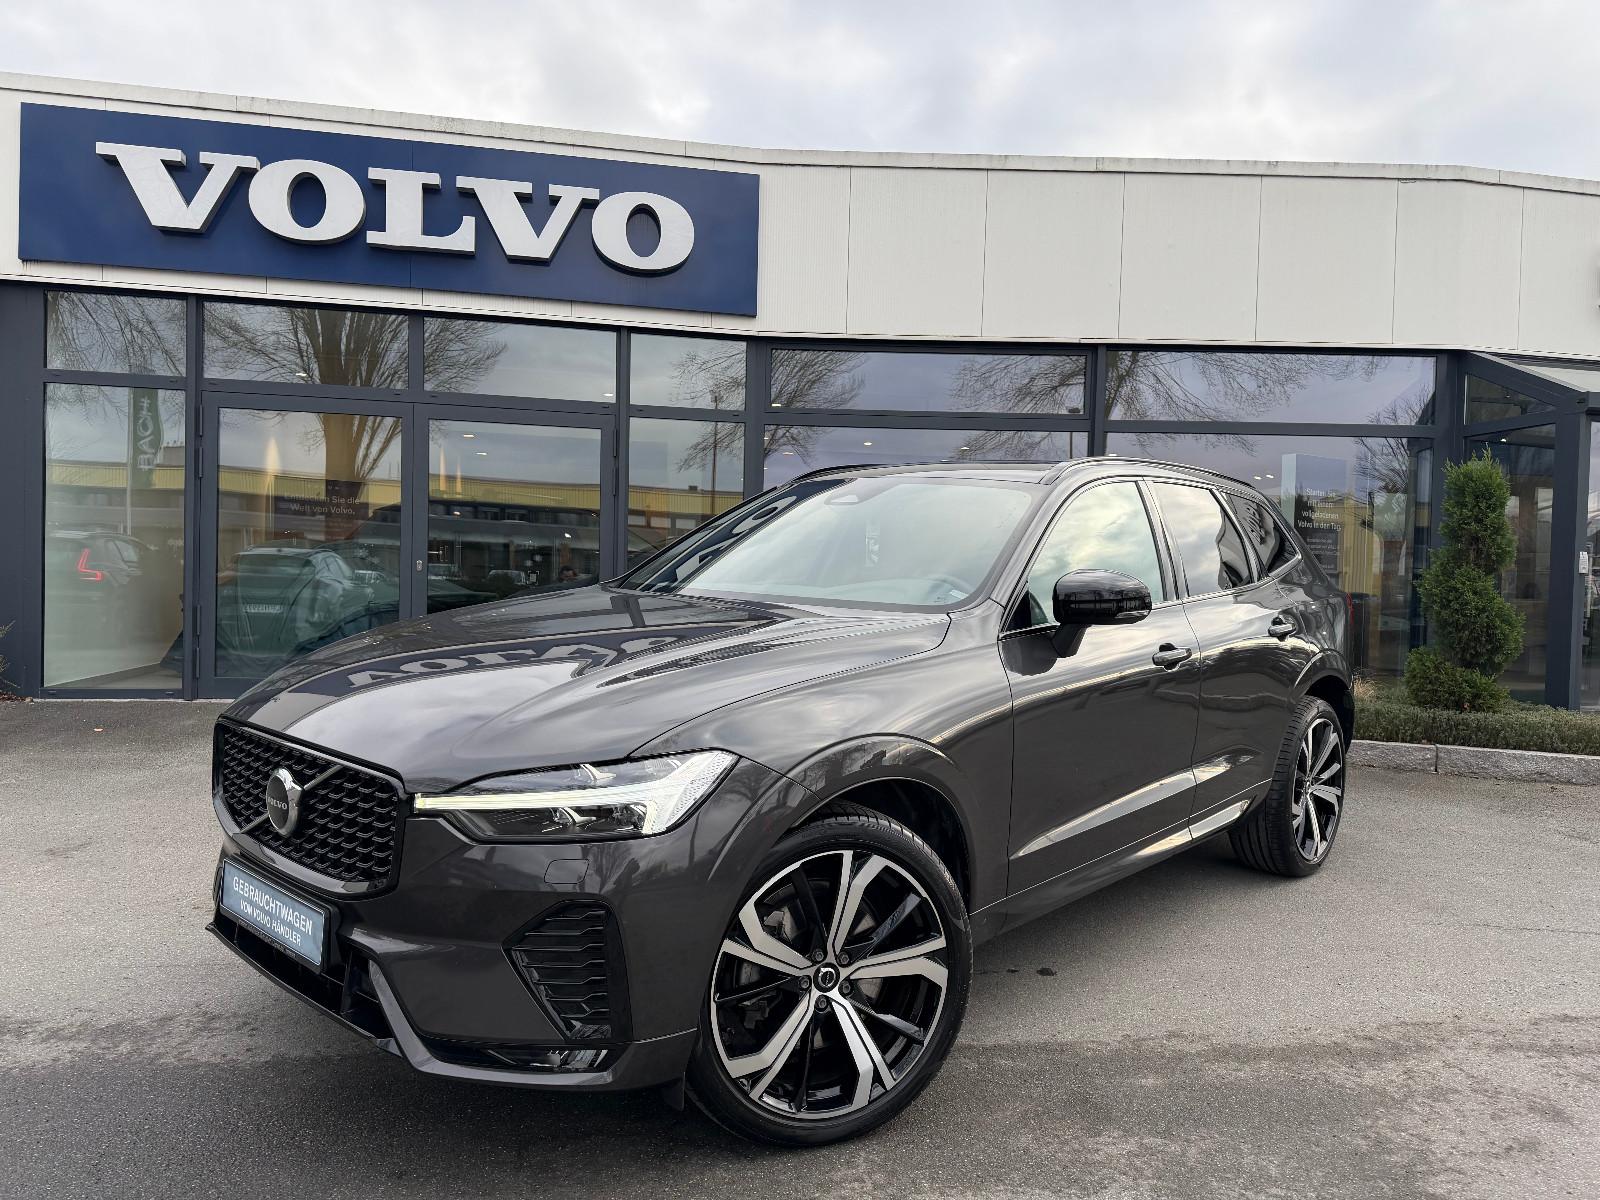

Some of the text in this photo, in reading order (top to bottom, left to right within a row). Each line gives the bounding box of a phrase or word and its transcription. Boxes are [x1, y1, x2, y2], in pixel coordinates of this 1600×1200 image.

[95, 141, 695, 275] VOLVO
[331, 495, 346, 504] Sie
[347, 496, 360, 505] die
[233, 876, 313, 936] GEBRAUCHTWAGEN
[240, 900, 253, 916] VOM
[253, 907, 271, 928] VOLVO
[271, 919, 301, 947] HÄNDLER
